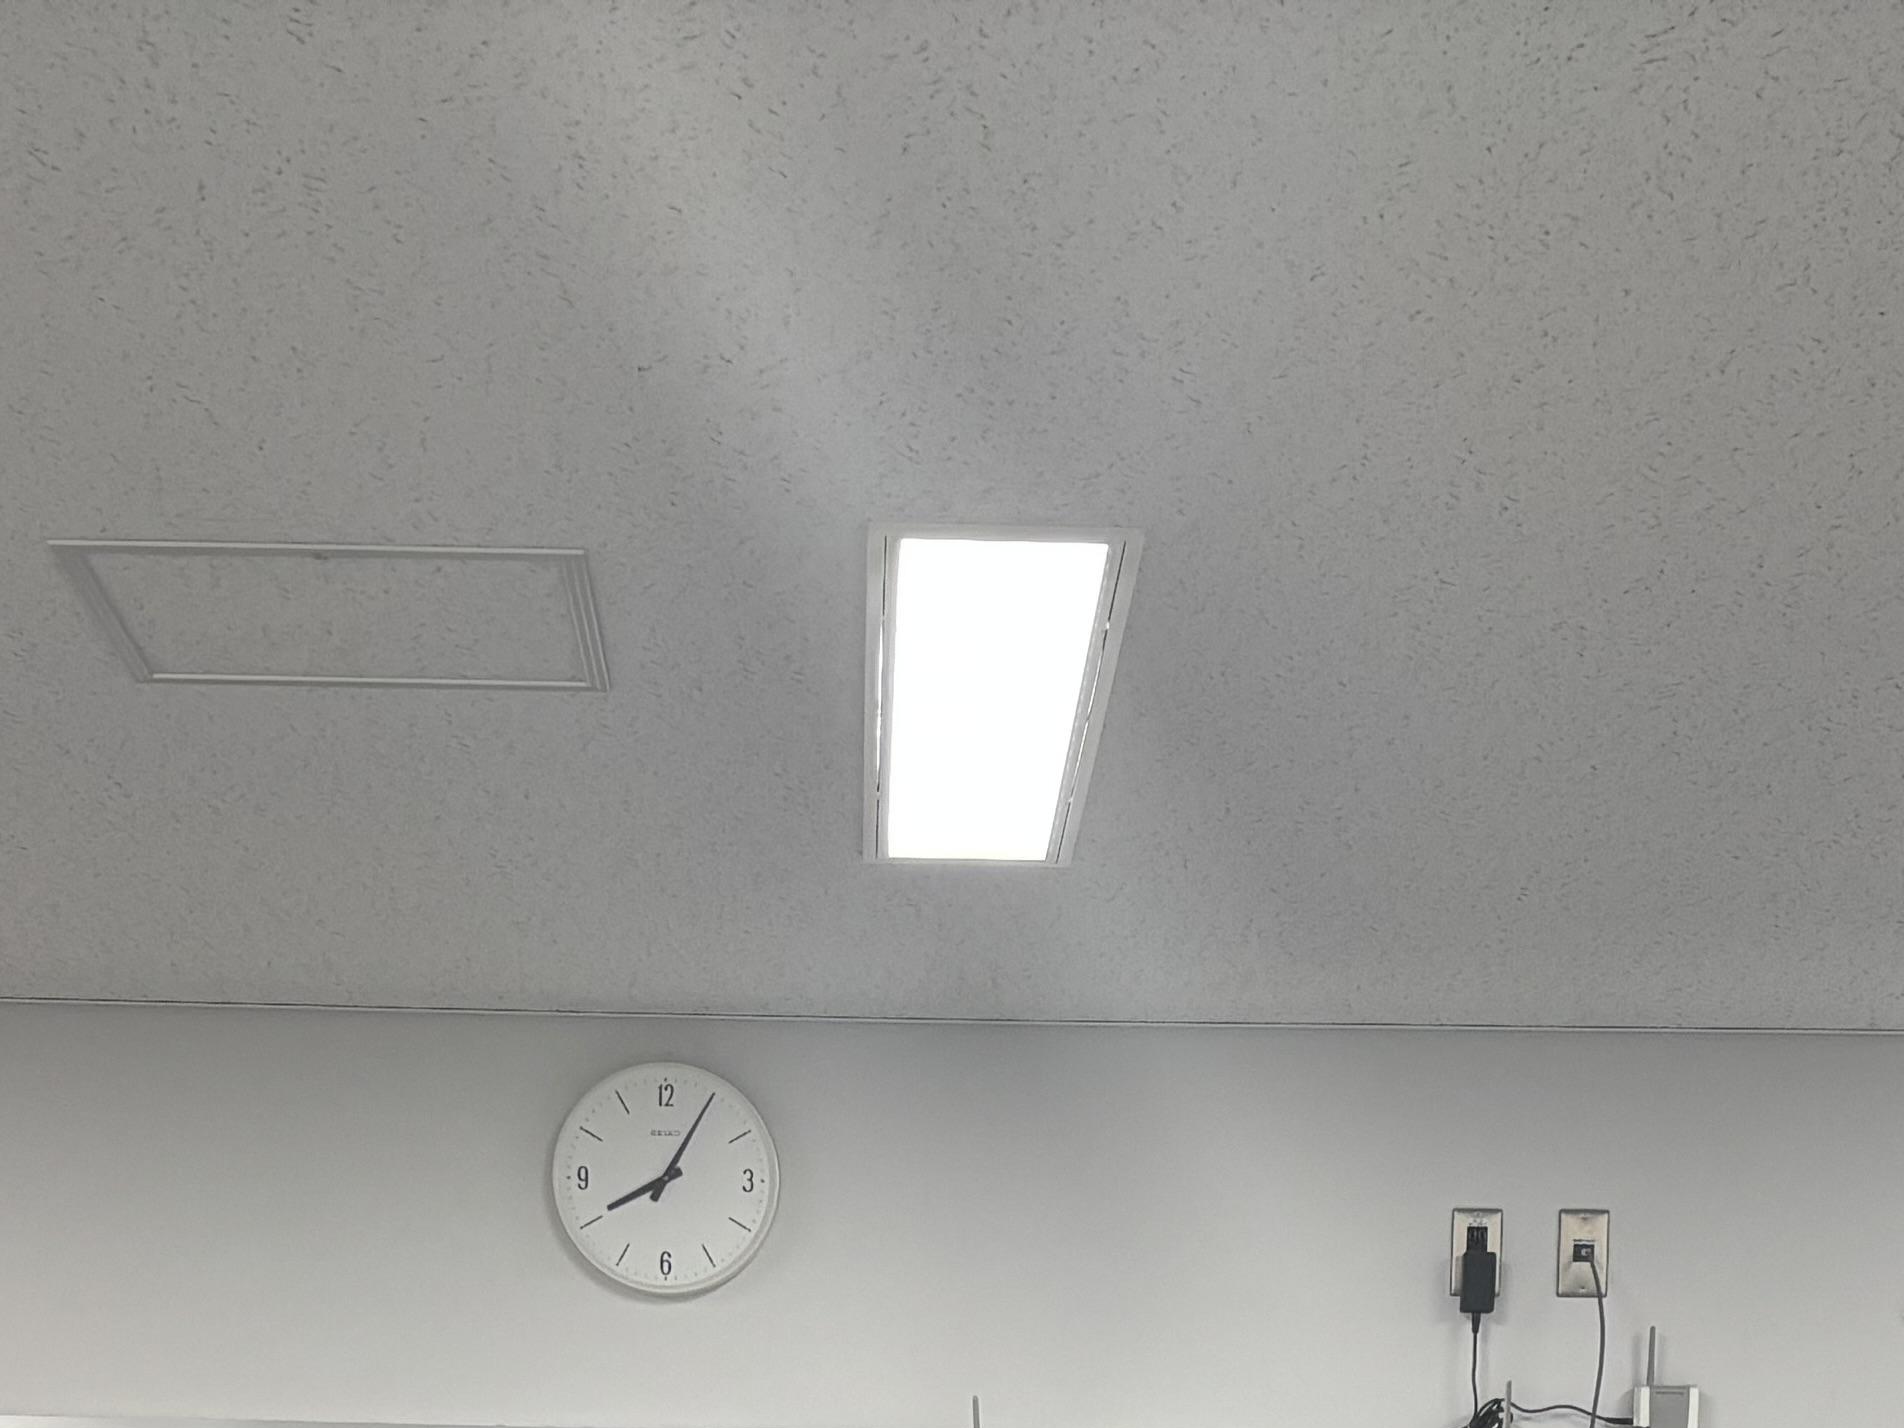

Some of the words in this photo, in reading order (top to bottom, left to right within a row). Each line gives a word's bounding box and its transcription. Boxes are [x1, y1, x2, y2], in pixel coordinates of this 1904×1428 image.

[658, 1083, 674, 1107] 12
[577, 1166, 589, 1190] 9
[743, 1169, 754, 1192] 3
[660, 1251, 672, 1275] 6
